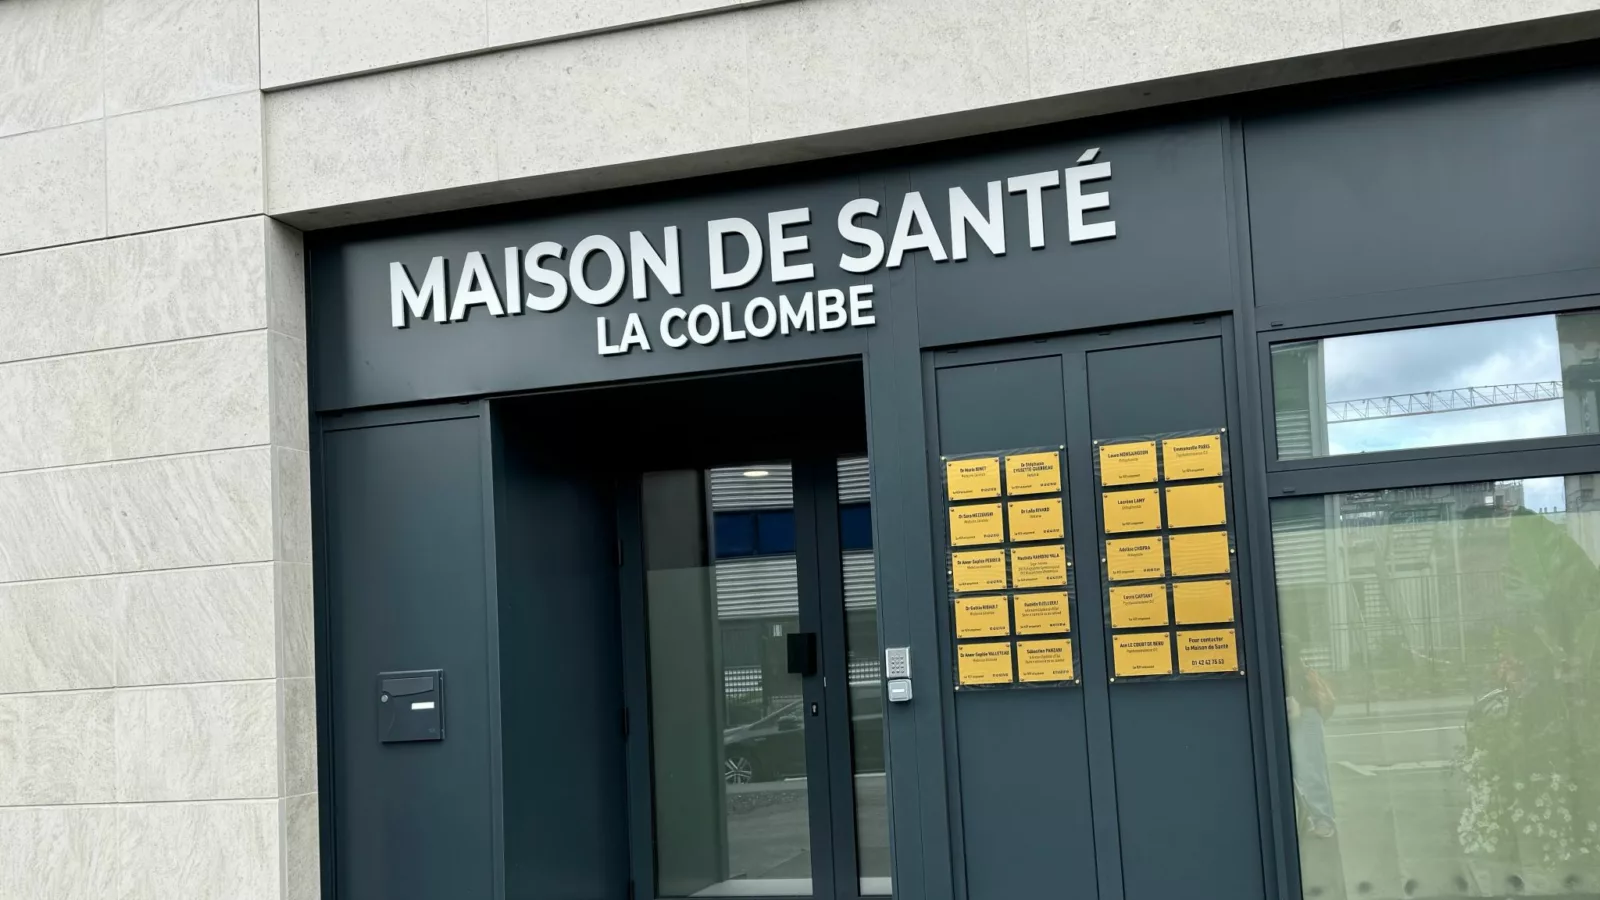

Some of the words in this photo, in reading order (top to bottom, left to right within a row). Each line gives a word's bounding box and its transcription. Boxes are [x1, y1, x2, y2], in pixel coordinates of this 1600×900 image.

[389, 225, 683, 329] MAISON
[708, 207, 816, 291] DE
[838, 147, 1118, 274] SANTÉ
[596, 312, 651, 356] LA
[660, 284, 877, 348] COLOMBE
